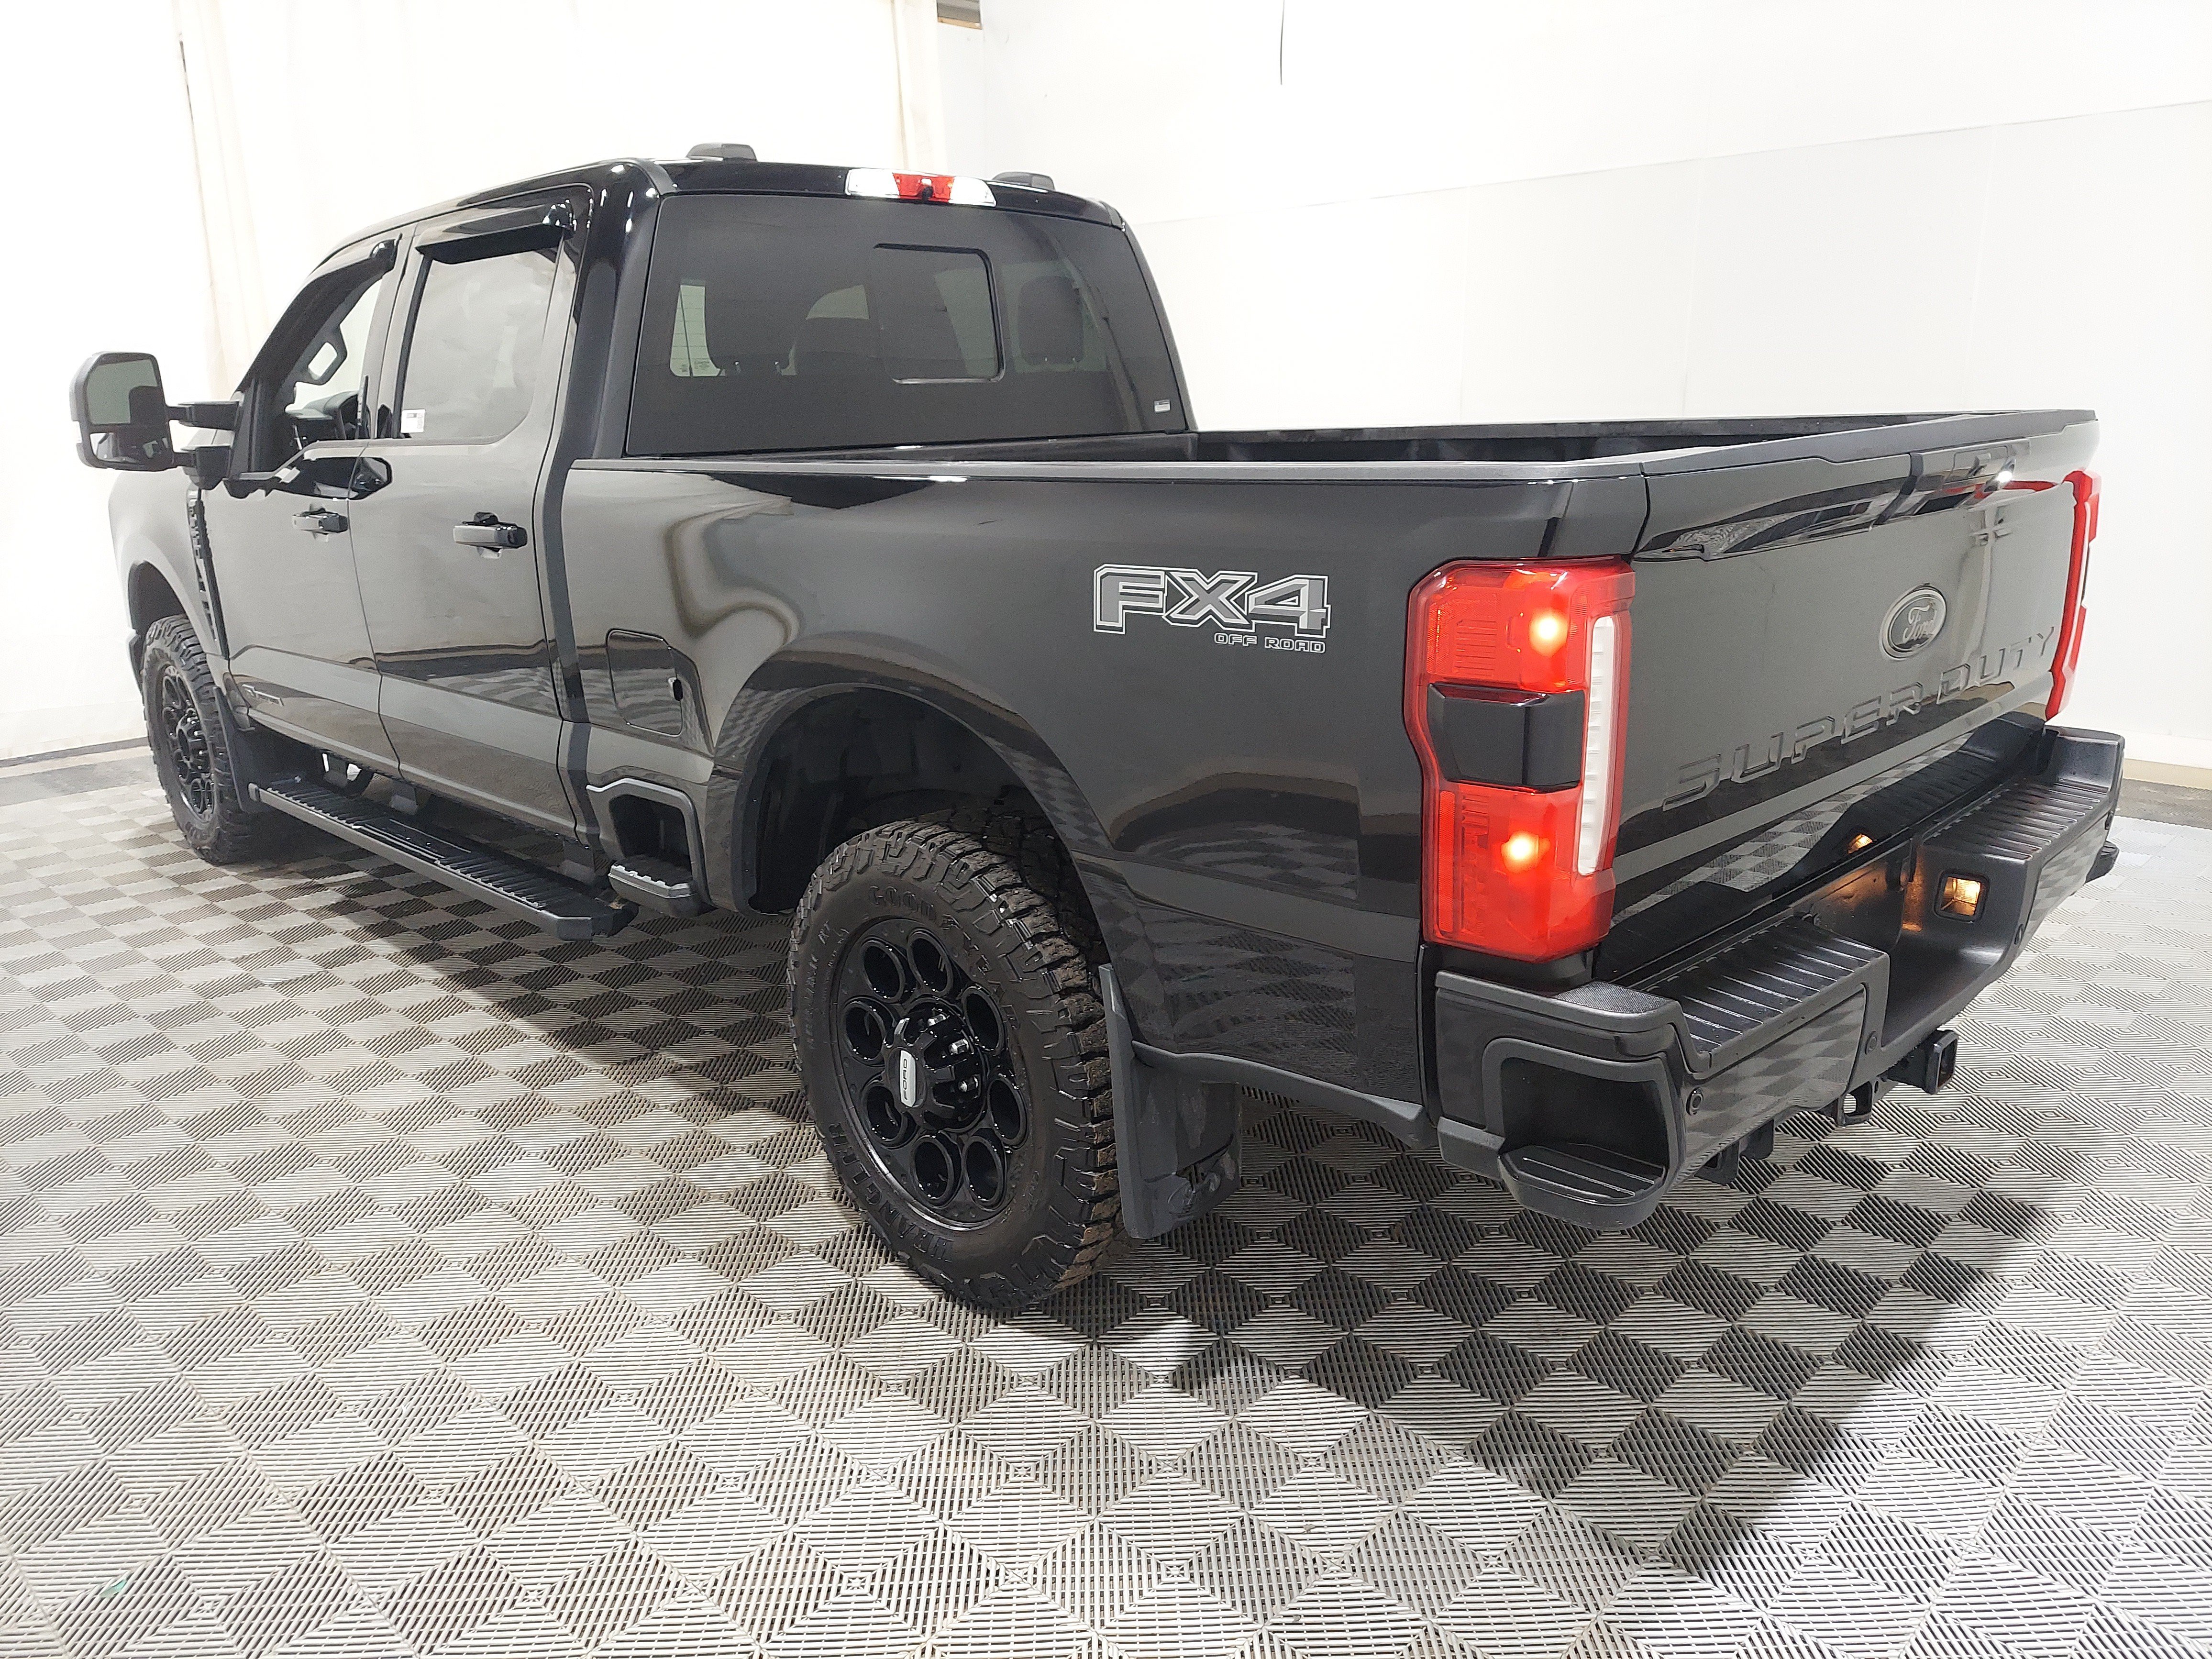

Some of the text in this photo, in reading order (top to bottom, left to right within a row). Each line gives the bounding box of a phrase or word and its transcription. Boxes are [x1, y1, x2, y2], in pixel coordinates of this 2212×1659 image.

[1094, 564, 1331, 638] FX4
[1214, 632, 1326, 654] OFF ROAD
[1662, 627, 2055, 811] SUPER DUTY
